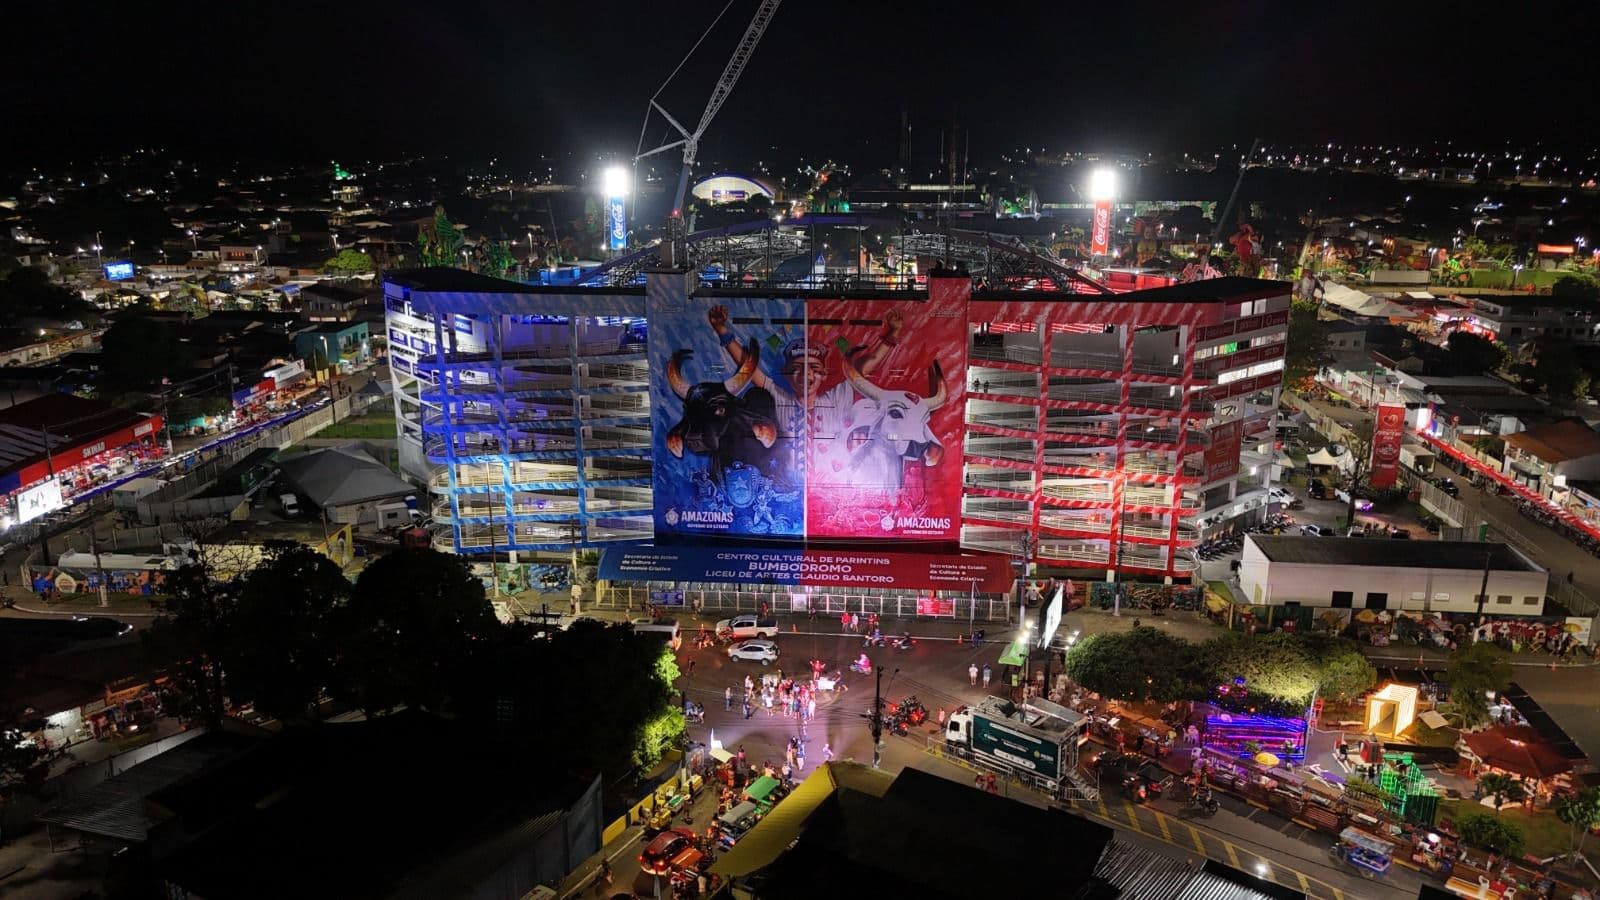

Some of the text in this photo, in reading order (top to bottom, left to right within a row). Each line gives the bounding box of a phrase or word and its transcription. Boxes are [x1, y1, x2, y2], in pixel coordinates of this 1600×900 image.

[681, 511, 734, 523] AMAZONAS
[897, 517, 951, 529] AMAZONAS
[717, 553, 759, 561] CENTRO
[762, 555, 817, 563] CULTURAL
[835, 557, 890, 565] PARINTINS
[705, 570, 736, 578] LICEU
[793, 573, 840, 581] CLAUDIO
[842, 574, 895, 583] SANTORO
